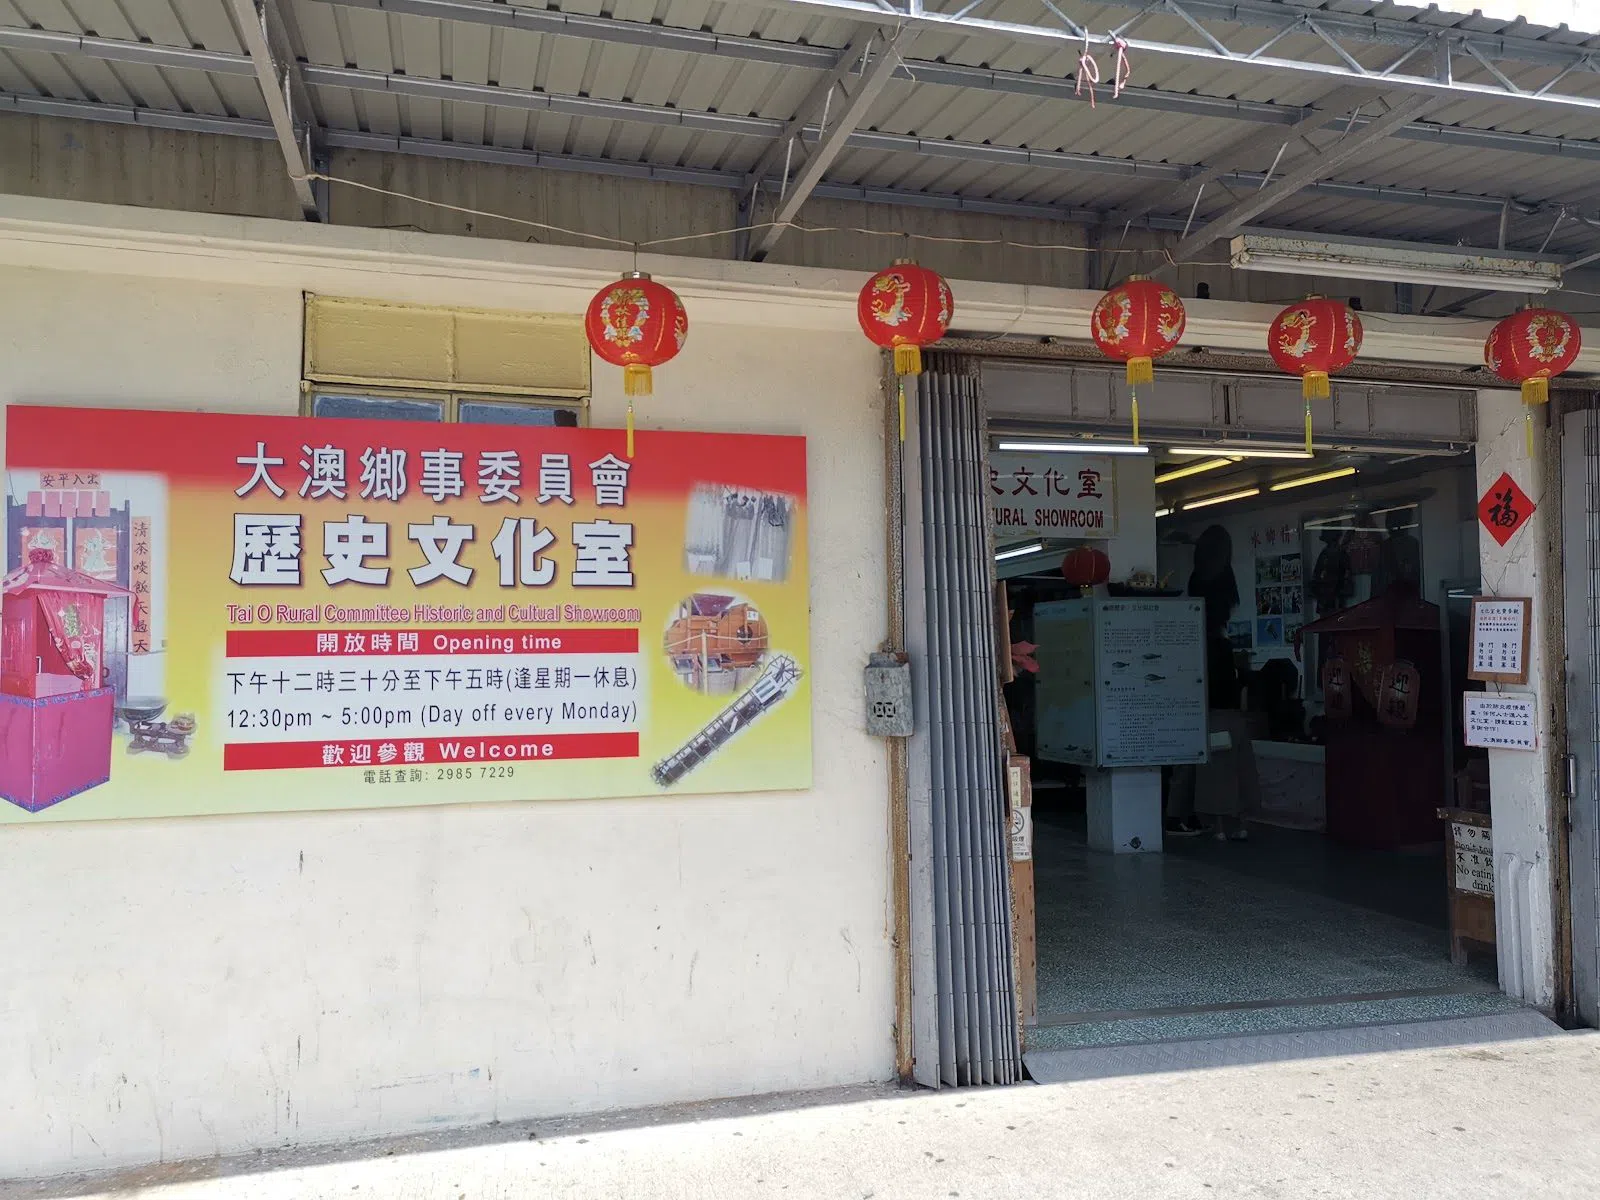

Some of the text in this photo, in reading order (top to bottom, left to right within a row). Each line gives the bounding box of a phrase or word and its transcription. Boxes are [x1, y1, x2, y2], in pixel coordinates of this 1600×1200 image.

[234, 441, 631, 507] 大澳鄉事委員會
[992, 508, 1104, 528] URAL SHOWROOM
[1488, 488, 1519, 528] 福
[228, 512, 635, 588] 歷史文化室
[227, 604, 641, 623] Tai O Rural Committee Historic and Cultual Showroom
[316, 632, 562, 653] 開放時間 Opening time
[227, 666, 638, 694] 下午十二時三十分至下午五時(逢星期一休息)
[228, 707, 313, 730] 12:30pm
[341, 706, 412, 728] 5:00pm
[420, 704, 463, 728] (Day
[472, 703, 496, 723] off
[504, 705, 554, 724] every
[561, 700, 638, 723] Monday)
[322, 741, 555, 765] 歡迎參觀 Welcome
[363, 765, 515, 784] 電話查詢: 2985 7229
[1456, 864, 1470, 875] No
[1472, 880, 1494, 893] drink
